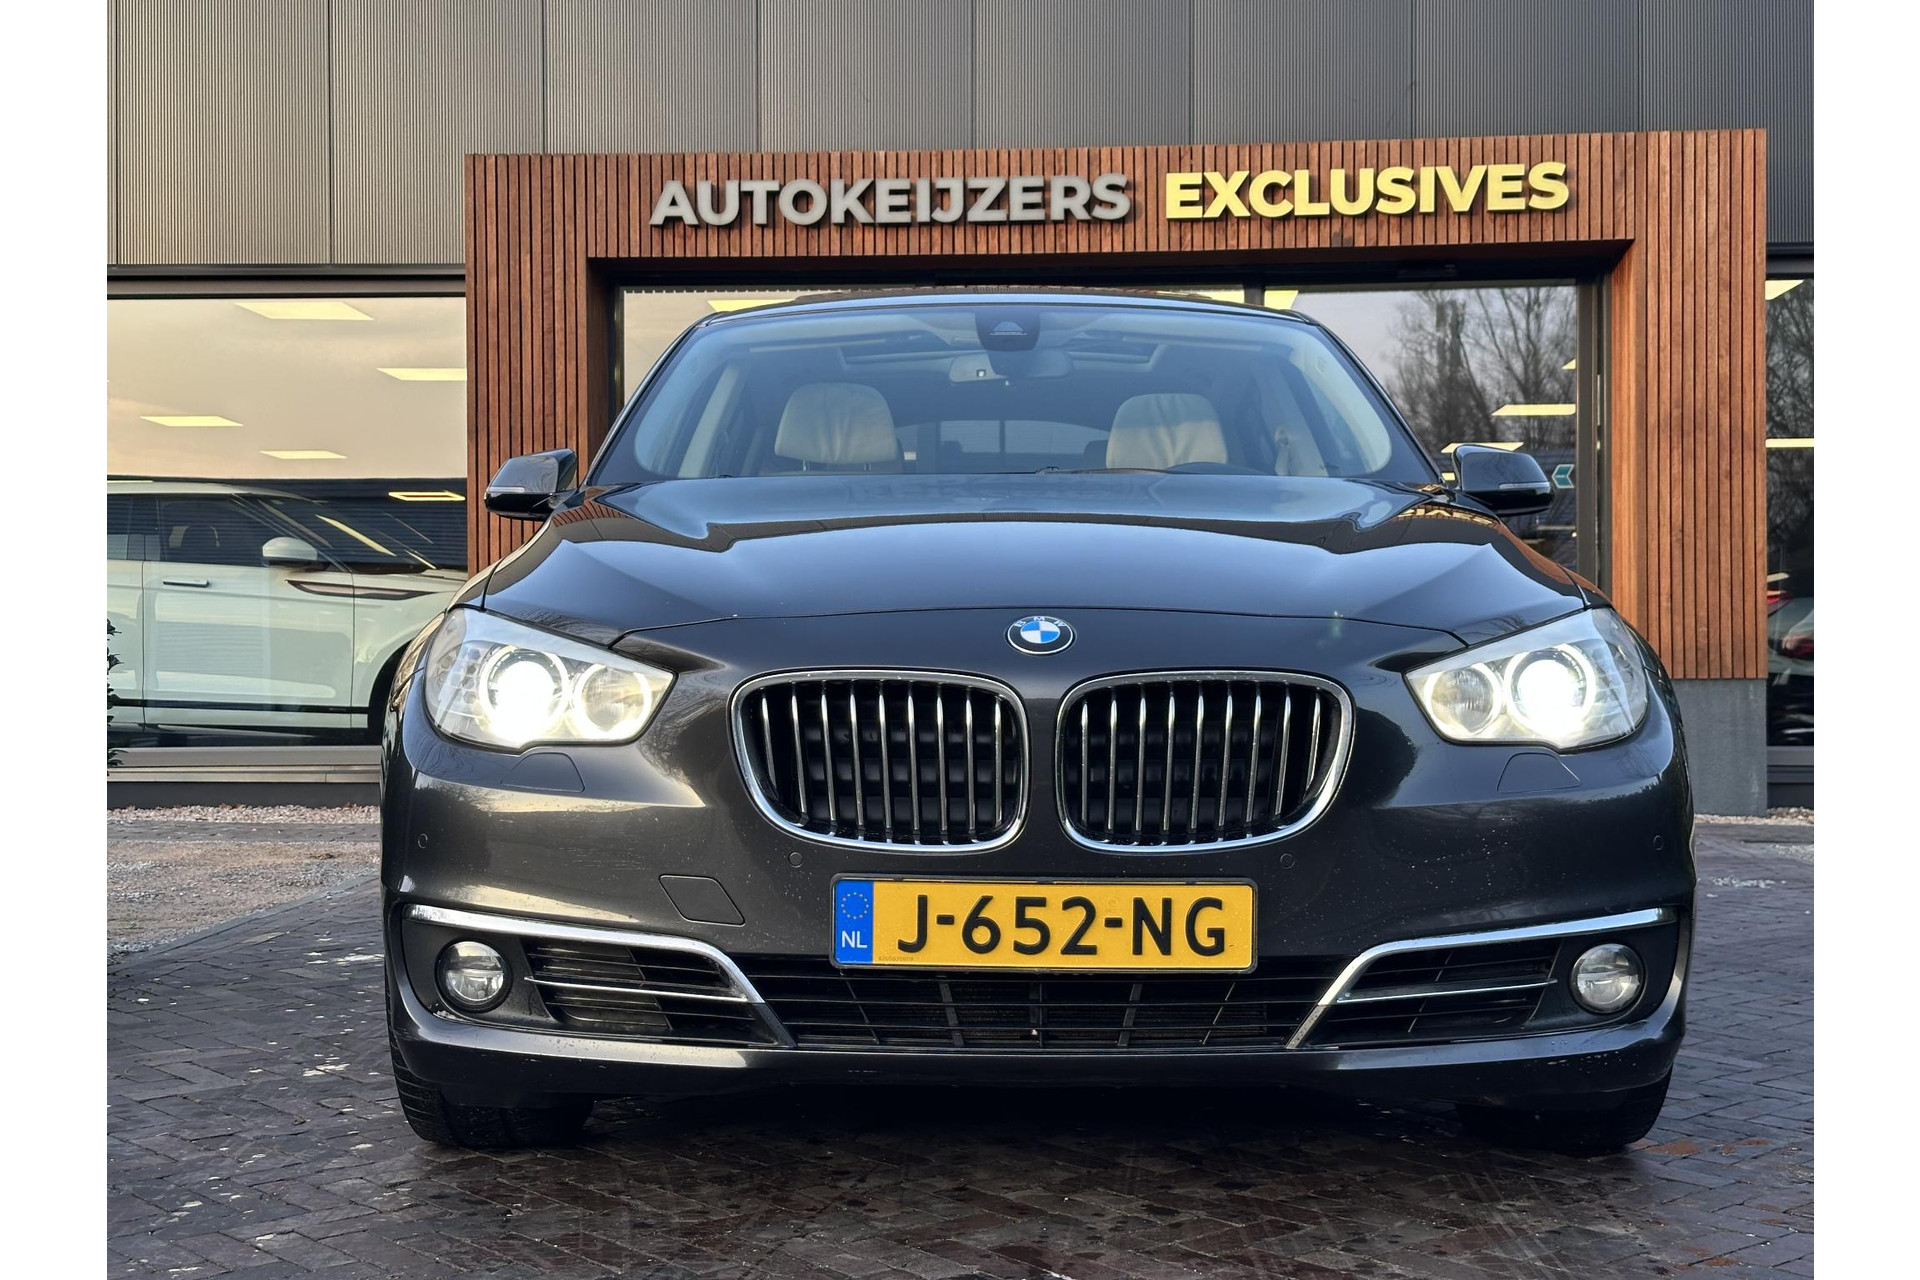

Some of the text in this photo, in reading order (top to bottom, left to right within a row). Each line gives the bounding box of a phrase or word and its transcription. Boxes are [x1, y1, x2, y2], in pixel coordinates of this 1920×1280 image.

[649, 161, 1571, 226] AUTOKEIJZERS EXCLUSIVES
[841, 930, 868, 949] NL
[897, 894, 1226, 956] J-652-NG
